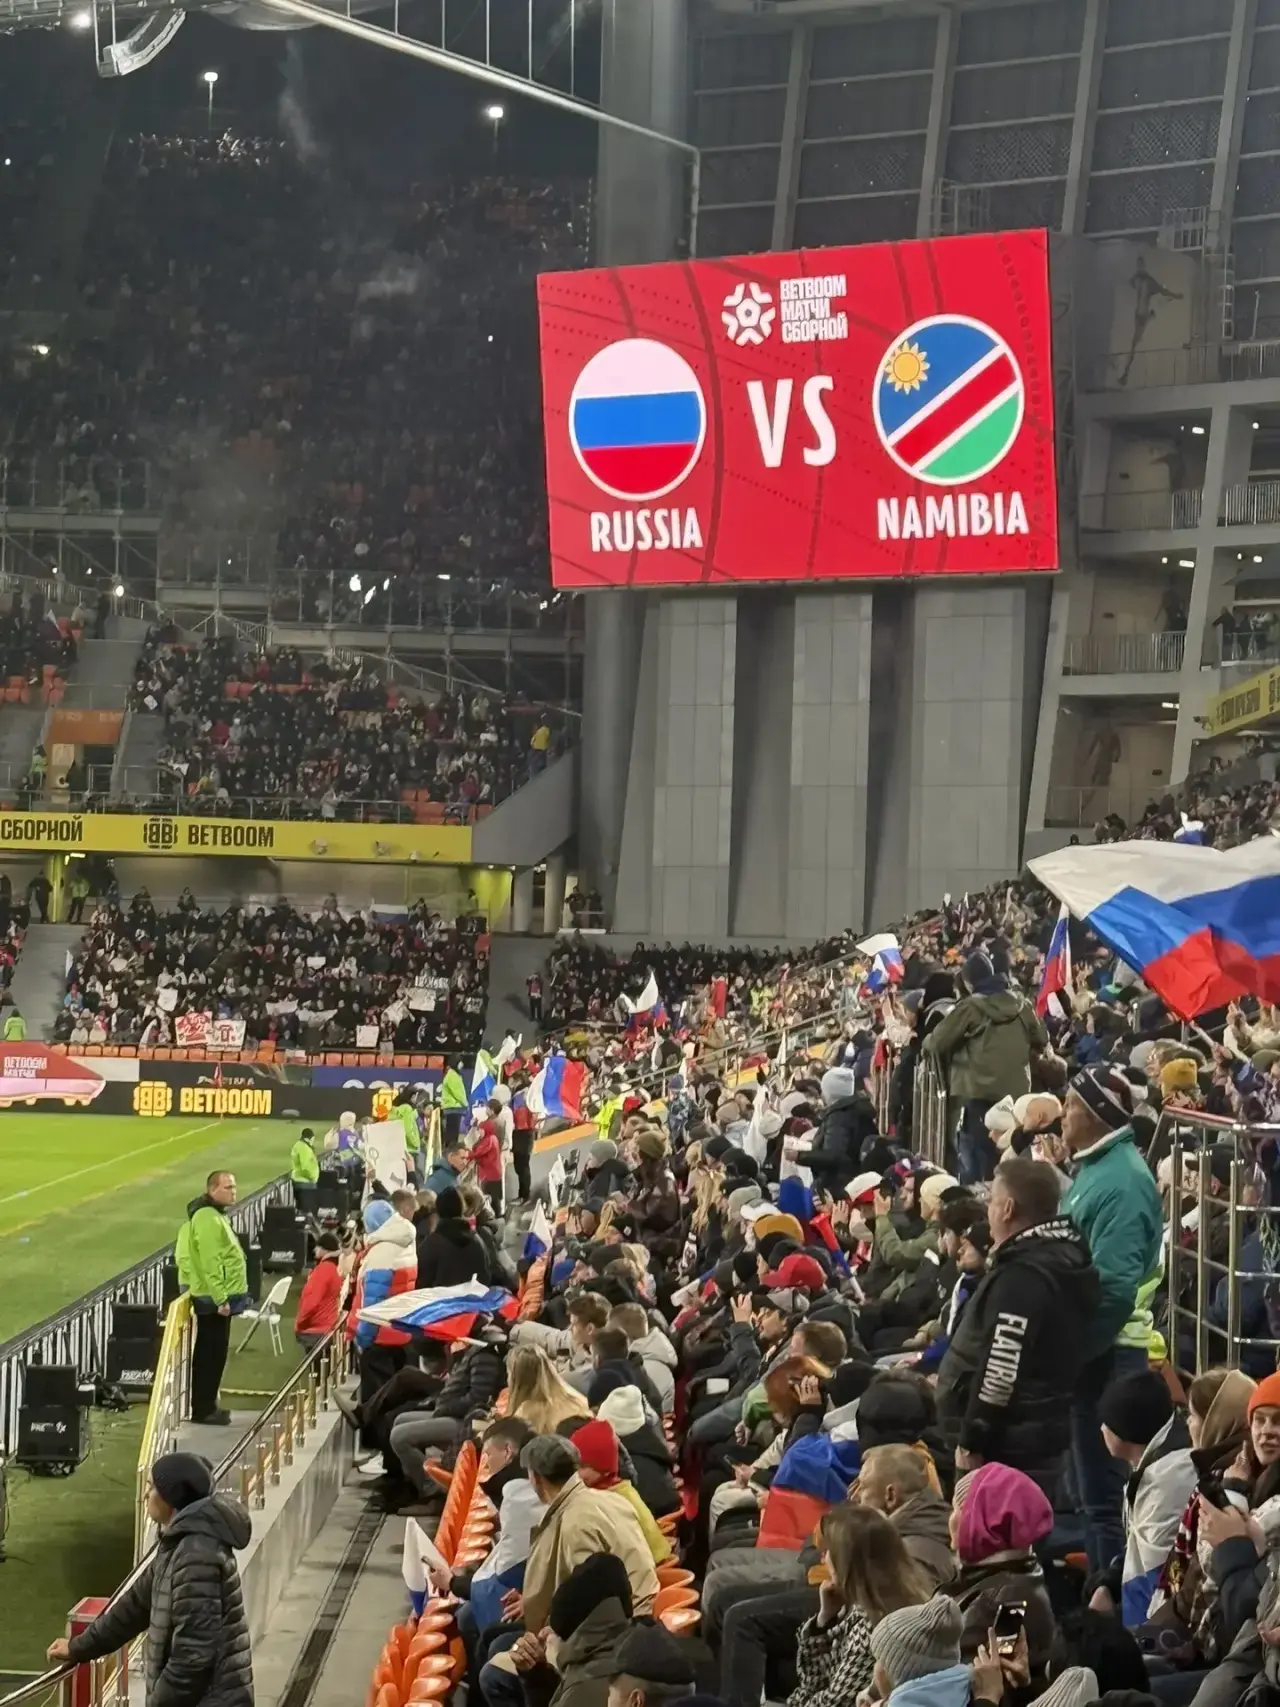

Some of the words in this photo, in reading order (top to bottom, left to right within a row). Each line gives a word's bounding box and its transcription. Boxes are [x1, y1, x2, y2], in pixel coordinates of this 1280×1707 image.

[780, 274, 847, 300] BETBOOM
[781, 298, 831, 322] МАТЧИ
[782, 311, 849, 343] СБОРНОЙ
[746, 374, 837, 468] VS
[590, 506, 704, 552] RUSSIA
[877, 490, 1030, 540] NAMIBIA
[1, 814, 83, 842] СБОРНОЙ
[188, 824, 274, 848] BETBOOM
[179, 1087, 272, 1115] BETBOOM
[978, 1312, 1029, 1407] FLATIRON
